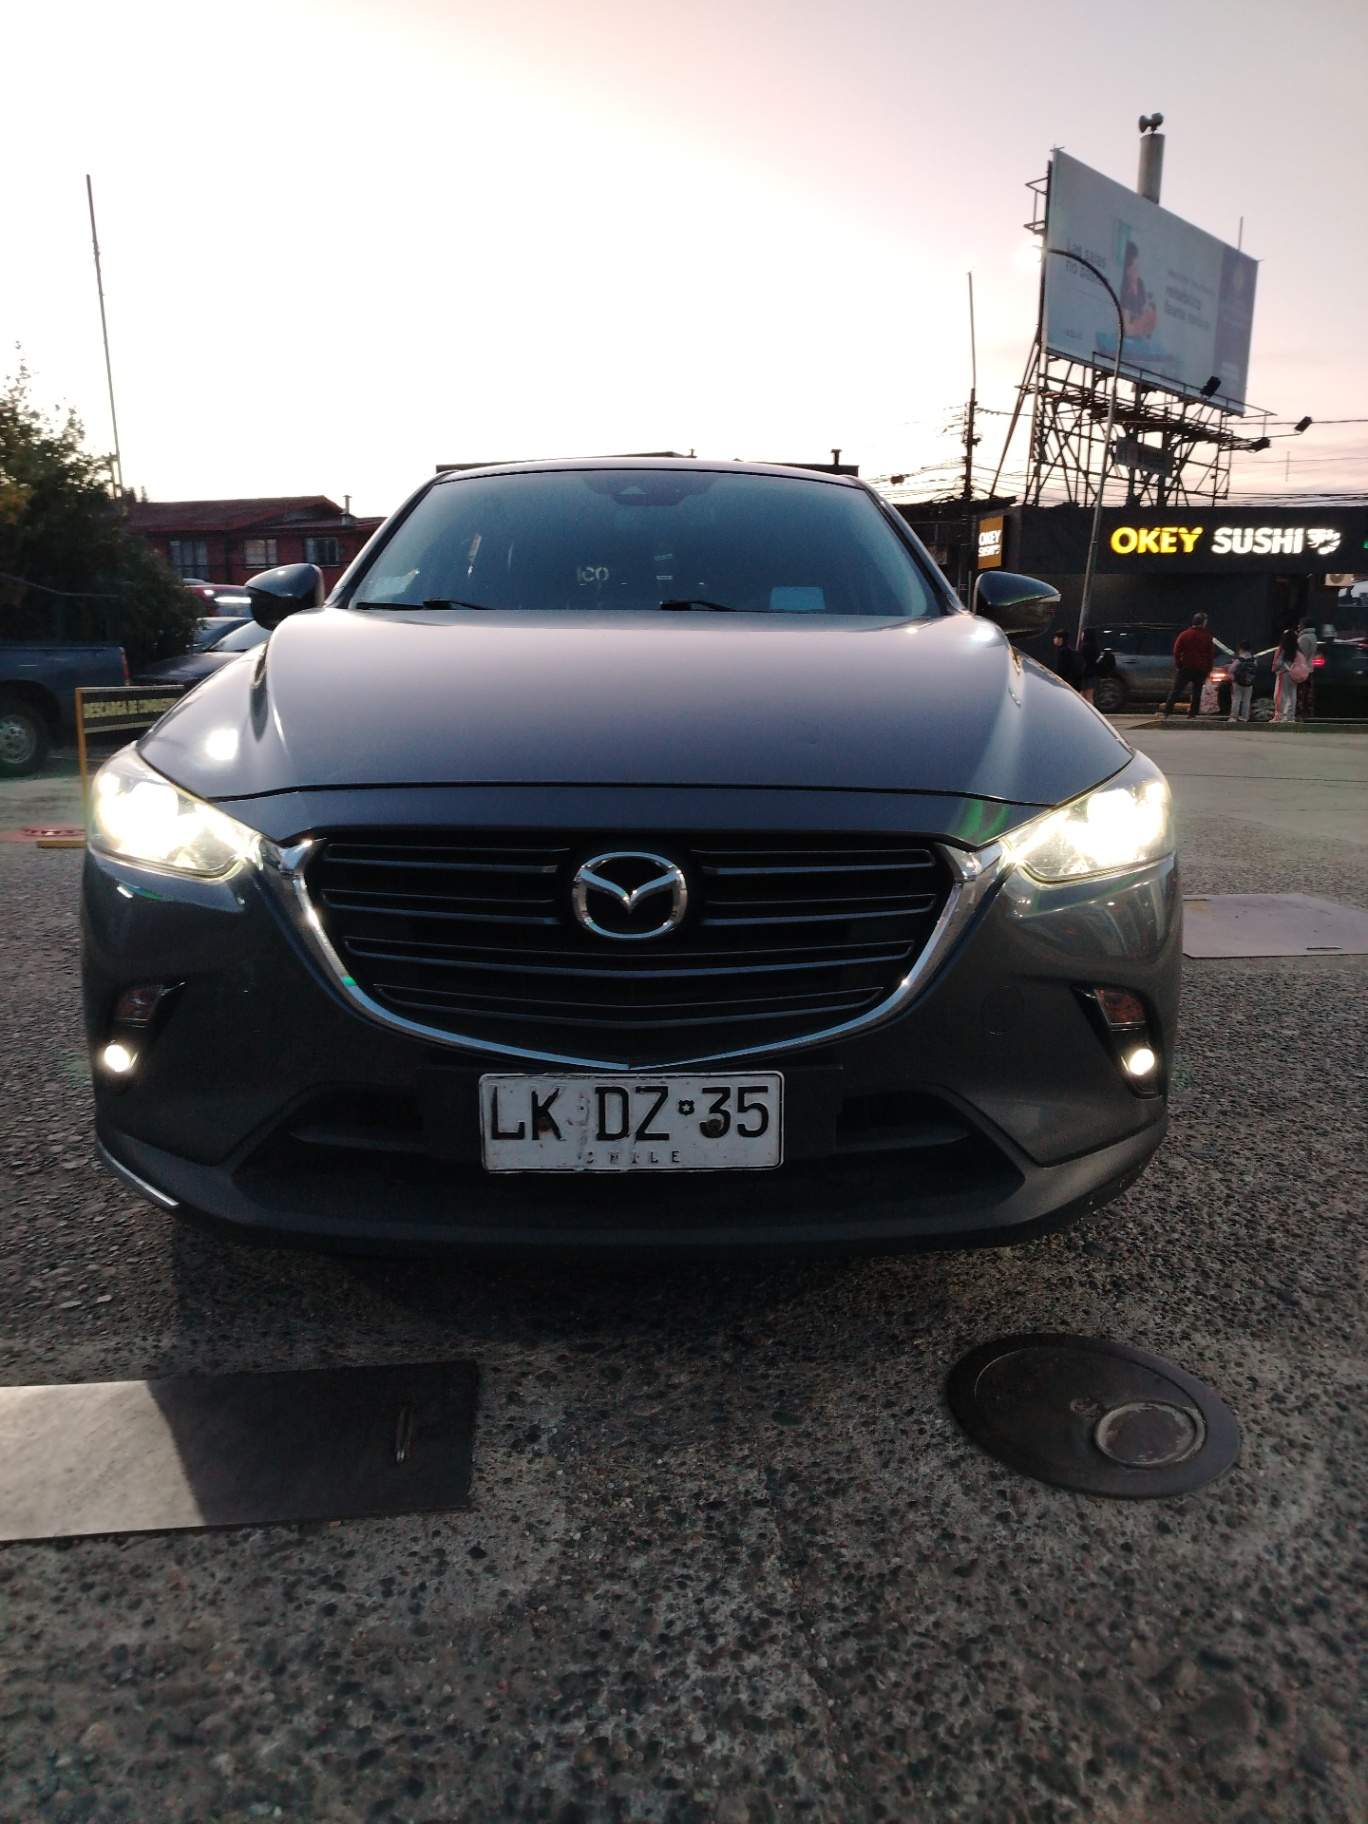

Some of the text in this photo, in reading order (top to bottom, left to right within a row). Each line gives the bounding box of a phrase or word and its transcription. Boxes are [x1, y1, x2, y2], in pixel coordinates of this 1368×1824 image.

[979, 529, 1002, 546] OKEY
[1111, 526, 1305, 555] OKEY SUSHI
[490, 1086, 770, 1141] LK DZ 35
